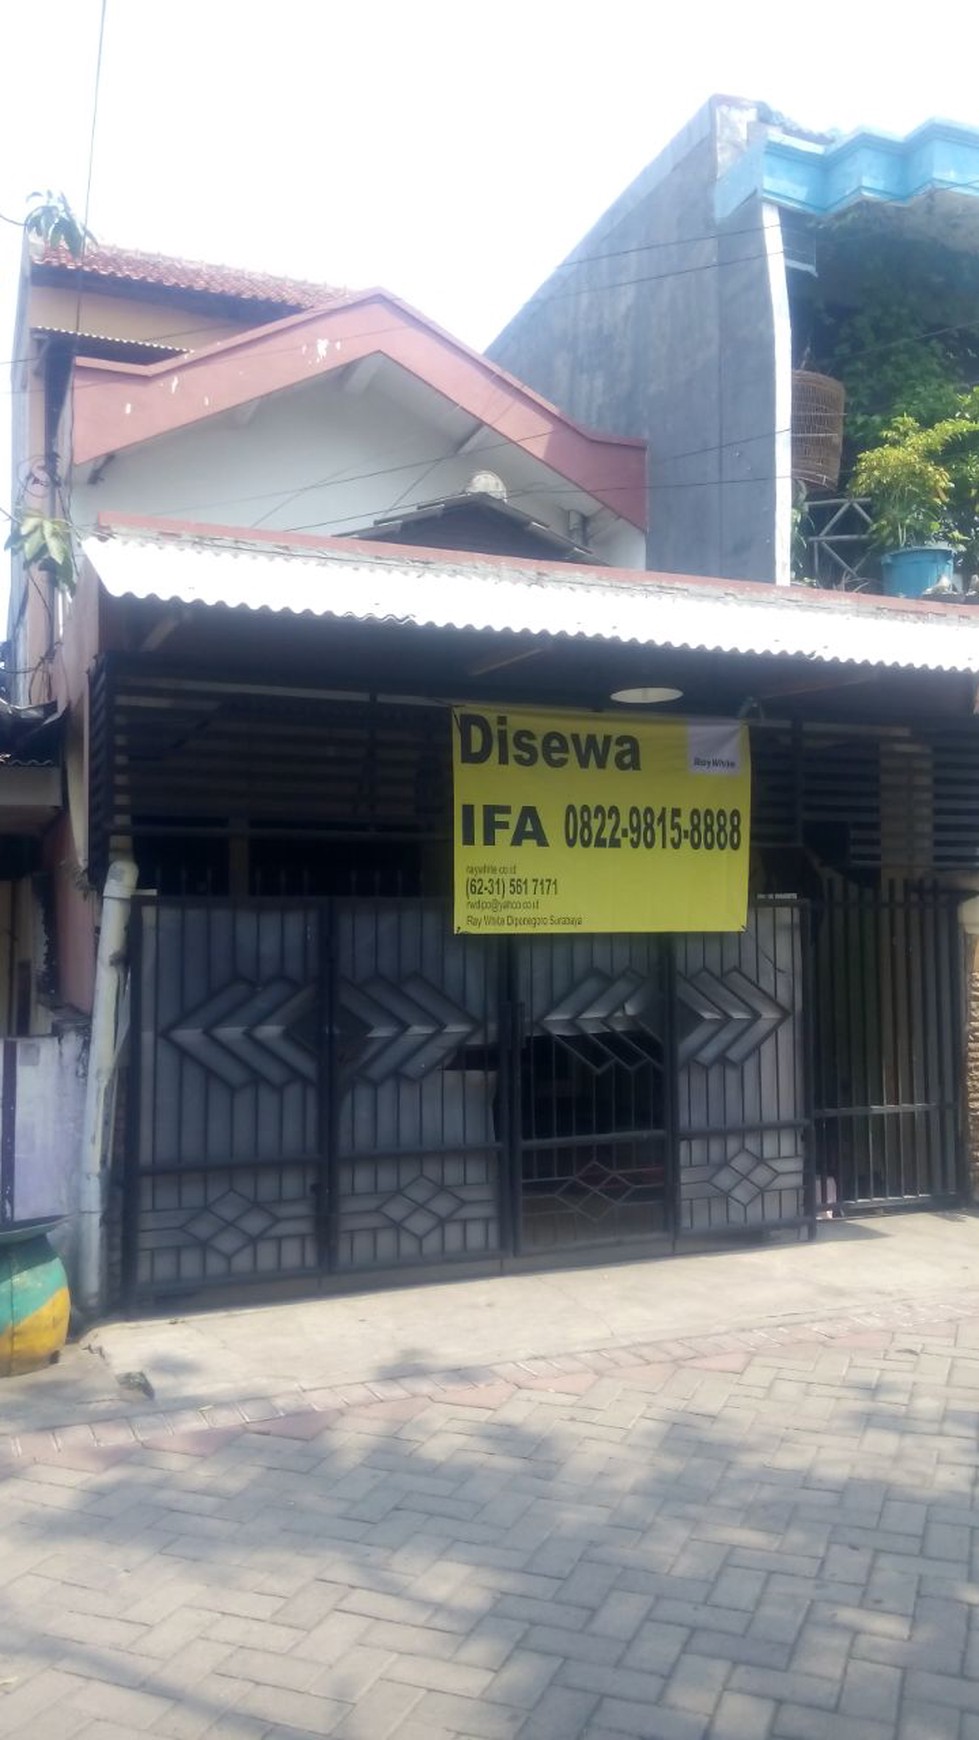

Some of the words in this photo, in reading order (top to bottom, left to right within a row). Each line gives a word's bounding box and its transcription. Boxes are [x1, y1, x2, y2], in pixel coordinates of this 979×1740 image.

[460, 713, 641, 771] Disewa
[461, 805, 549, 847] IFA
[564, 804, 742, 850] 0822-9815-8888
[466, 877, 505, 898] (62-31)
[509, 878, 528, 895] 561
[532, 878, 557, 895] 7171
[467, 916, 481, 927] Ray
[484, 916, 504, 925] White
